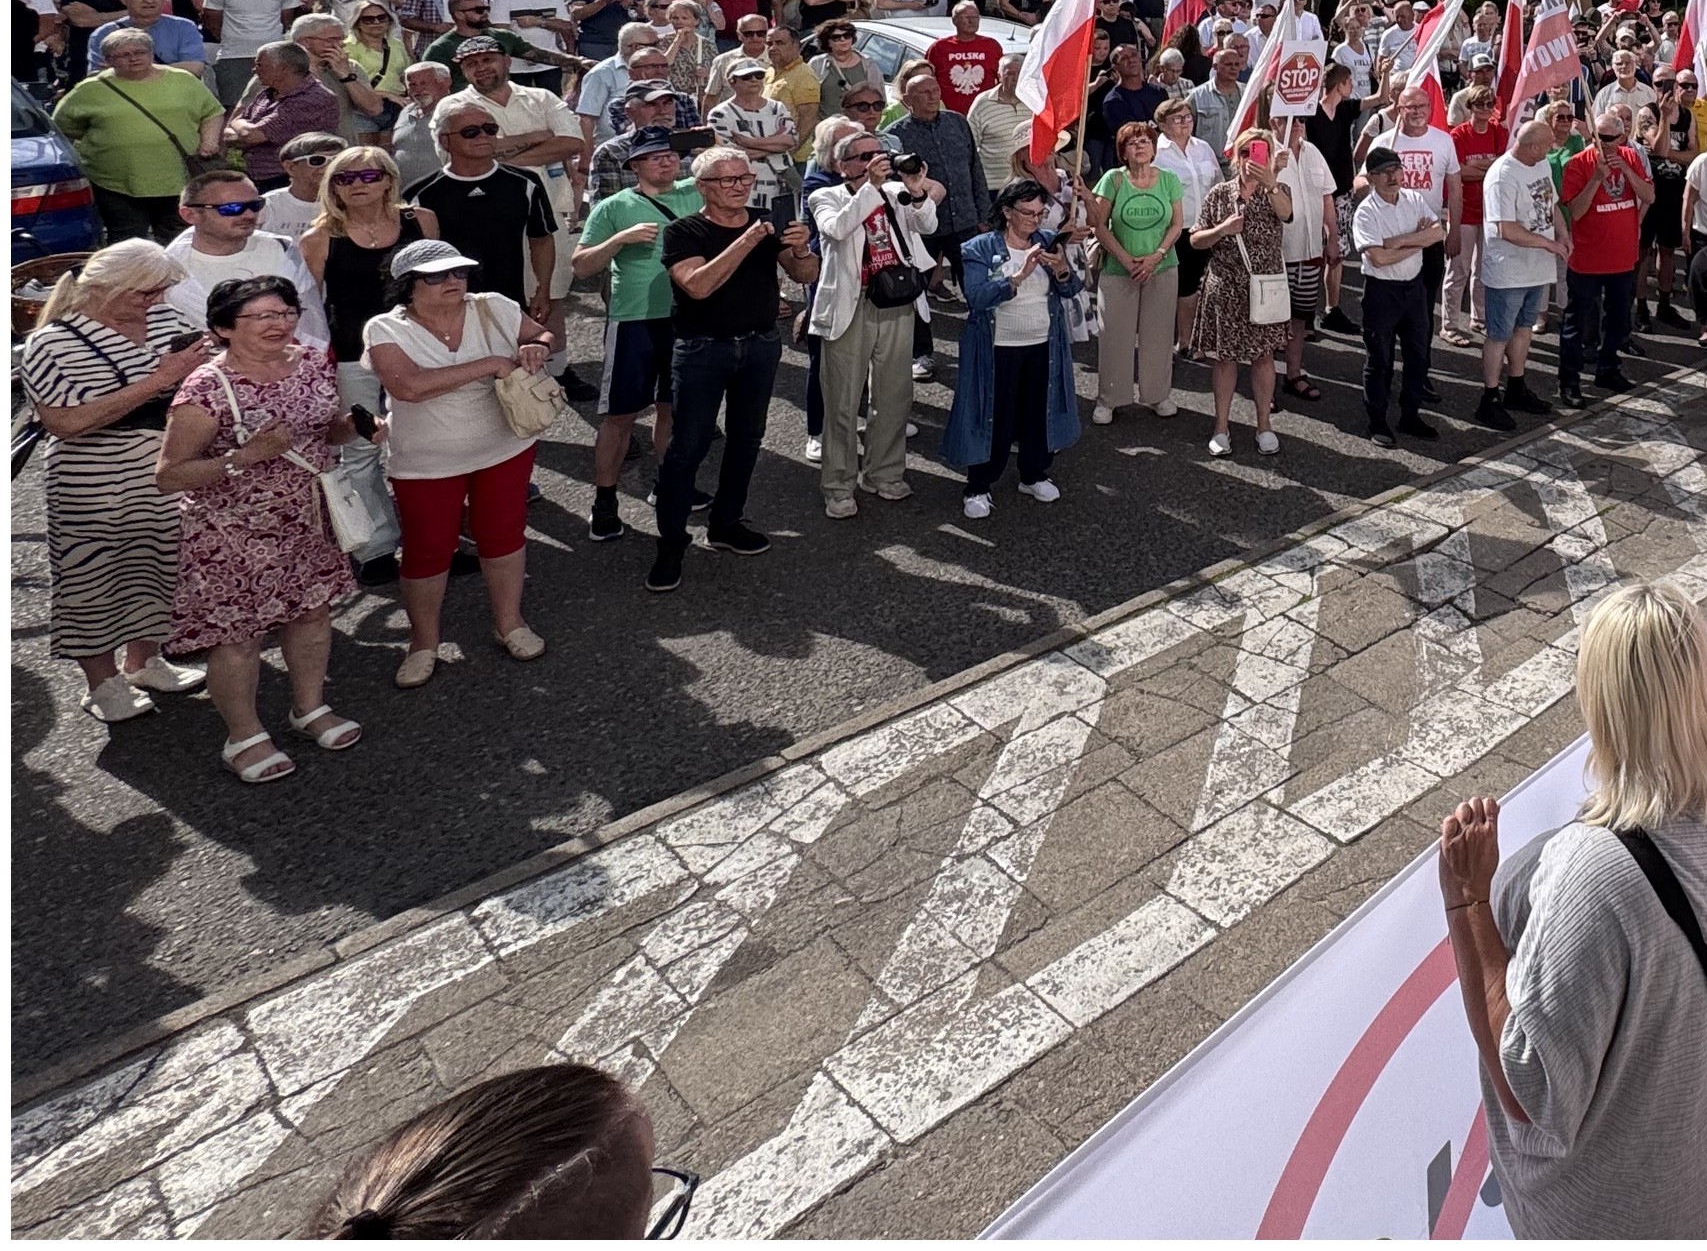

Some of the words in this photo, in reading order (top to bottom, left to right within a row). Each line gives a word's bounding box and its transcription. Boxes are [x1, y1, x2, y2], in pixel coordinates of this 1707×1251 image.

[949, 52, 985, 61] POLSKA
[1280, 68, 1318, 89] STOP
[1126, 207, 1159, 216] GREEN
